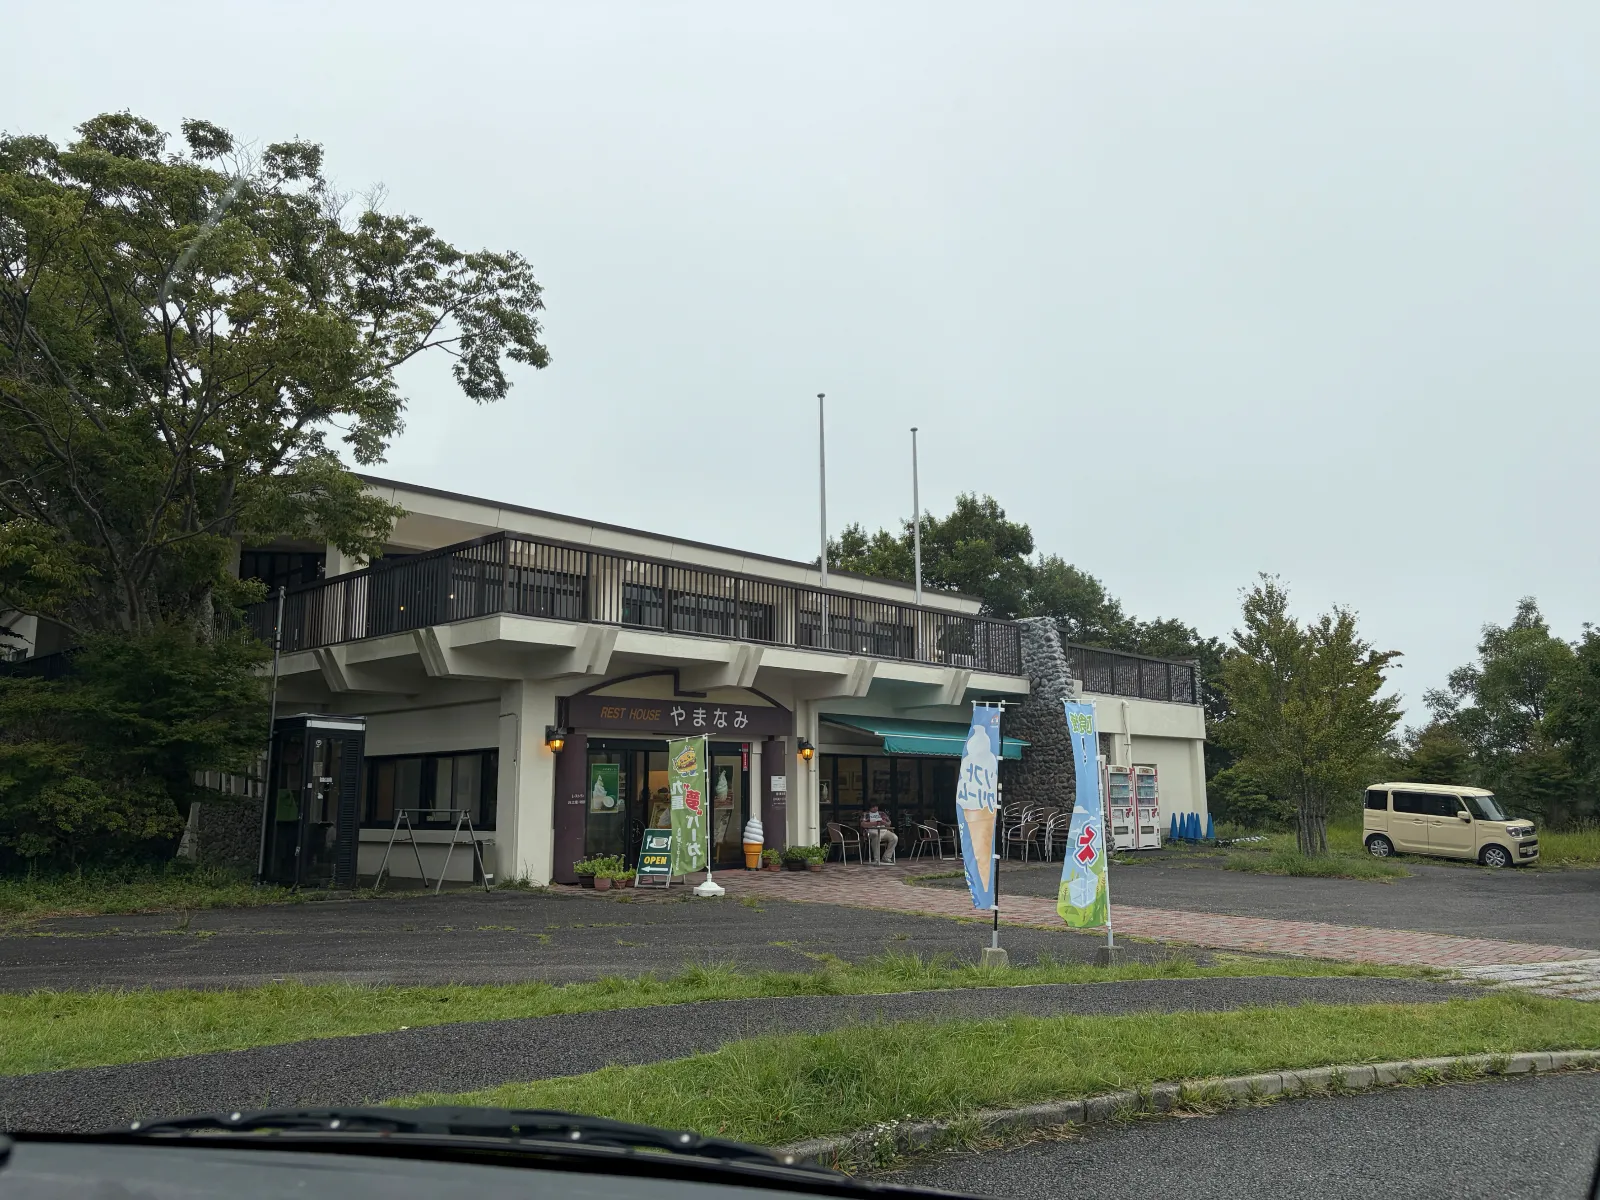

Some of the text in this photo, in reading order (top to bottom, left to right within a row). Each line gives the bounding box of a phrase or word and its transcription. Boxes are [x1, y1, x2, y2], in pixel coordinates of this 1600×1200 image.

[600, 706, 662, 721] REST HOUSE
[670, 705, 749, 729] やまなみ
[643, 856, 668, 865] OPEN
